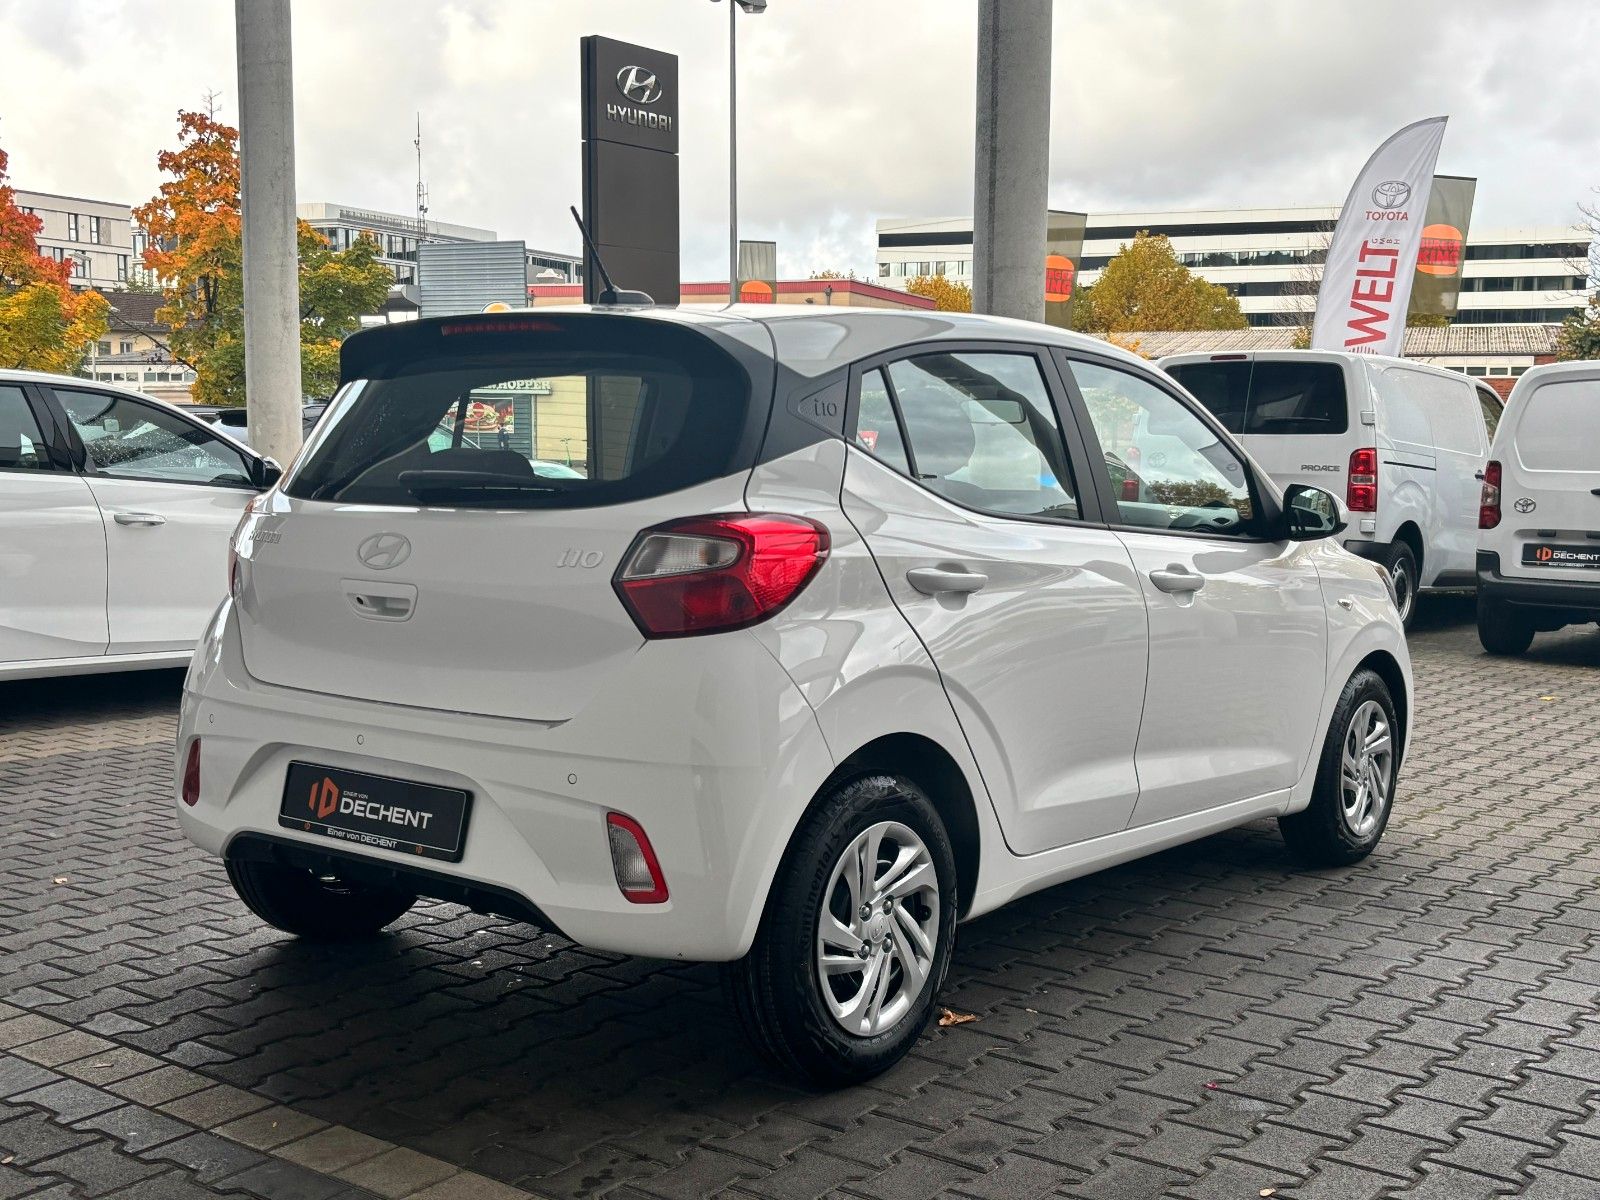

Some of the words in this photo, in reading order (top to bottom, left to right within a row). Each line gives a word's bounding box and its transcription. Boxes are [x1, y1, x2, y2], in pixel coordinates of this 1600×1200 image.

[606, 103, 672, 132] HYUNDAI
[1365, 211, 1408, 221] TOYOTA
[1046, 280, 1072, 294] ING
[1344, 239, 1399, 347] WELT
[1300, 464, 1341, 472] PROACE
[1553, 552, 1600, 561] DECHENT
[340, 798, 433, 830] DECHENT
[327, 827, 346, 838] Einer
[346, 832, 360, 841] von
[360, 834, 398, 849] DECHENT
